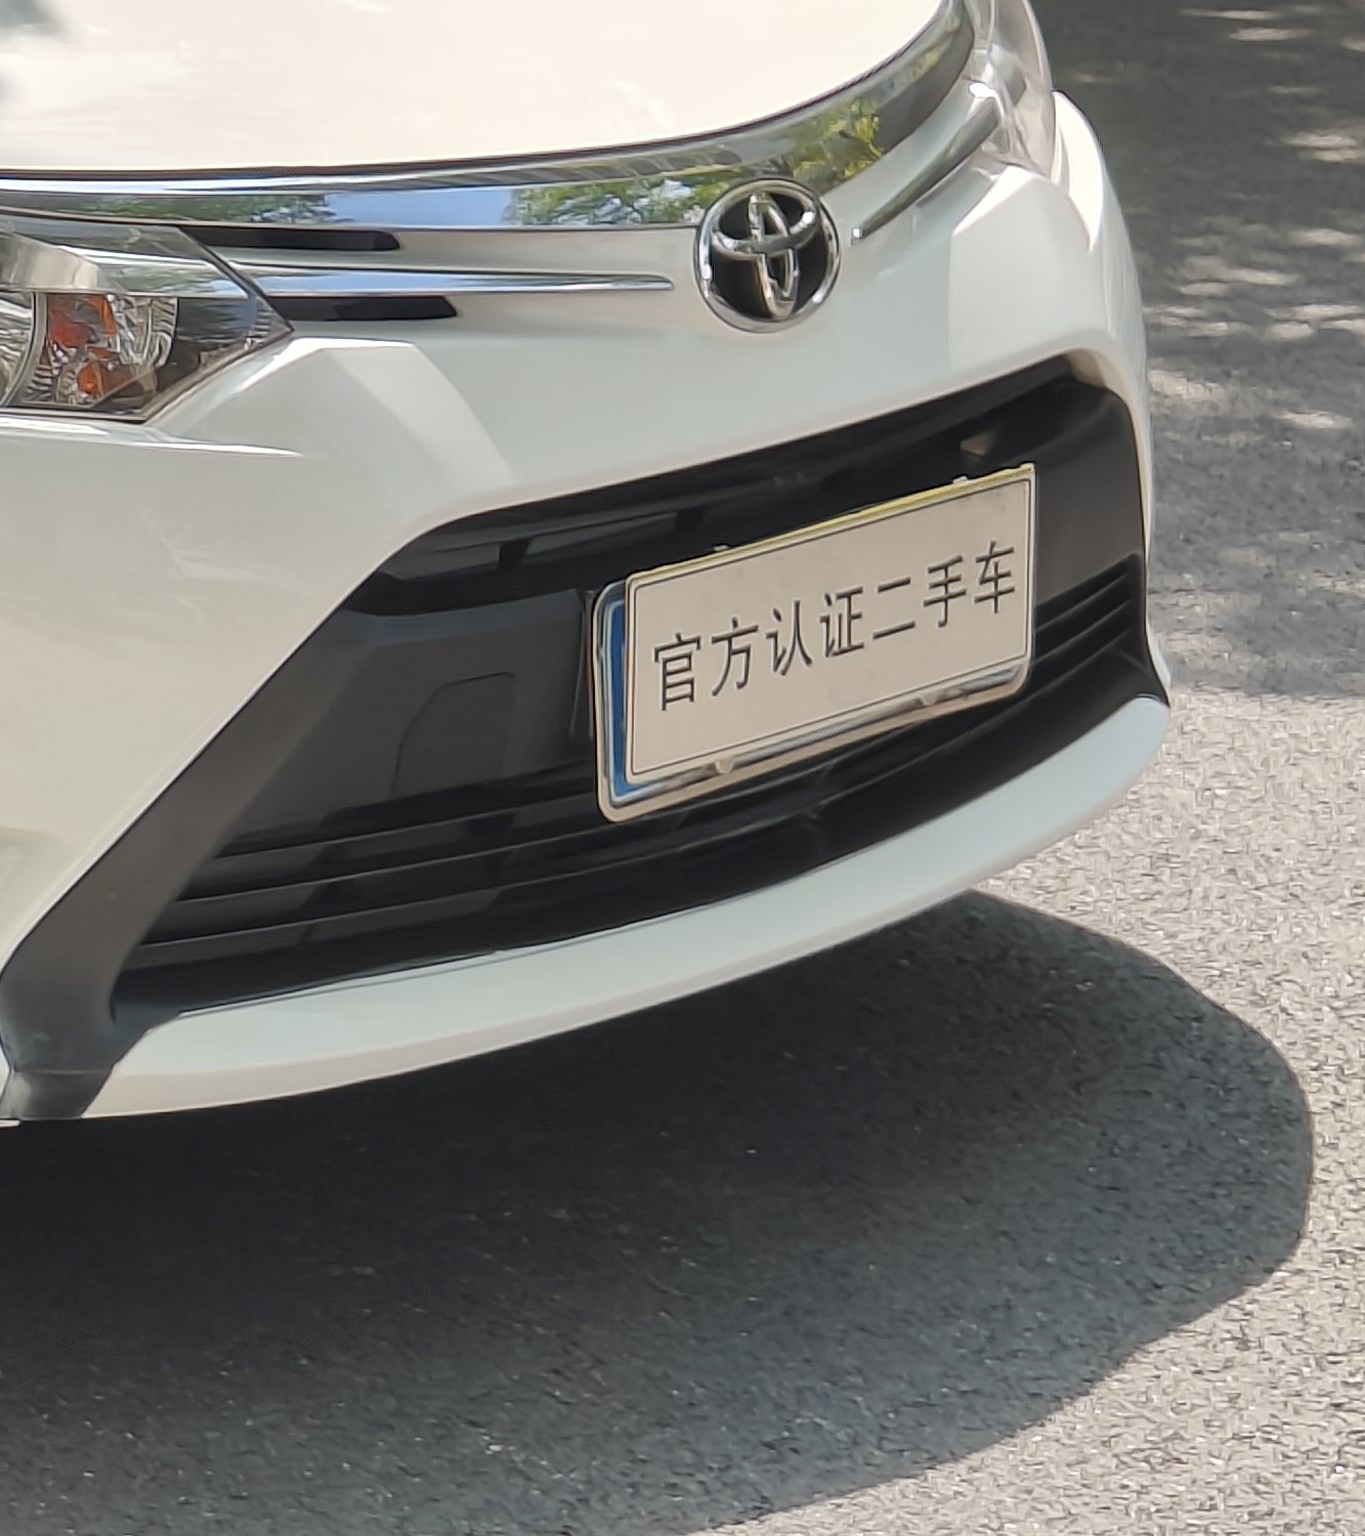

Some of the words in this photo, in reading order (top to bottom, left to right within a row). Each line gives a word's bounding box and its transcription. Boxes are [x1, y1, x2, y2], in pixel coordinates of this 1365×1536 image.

[653, 539, 1017, 713] 官方认证二手车
